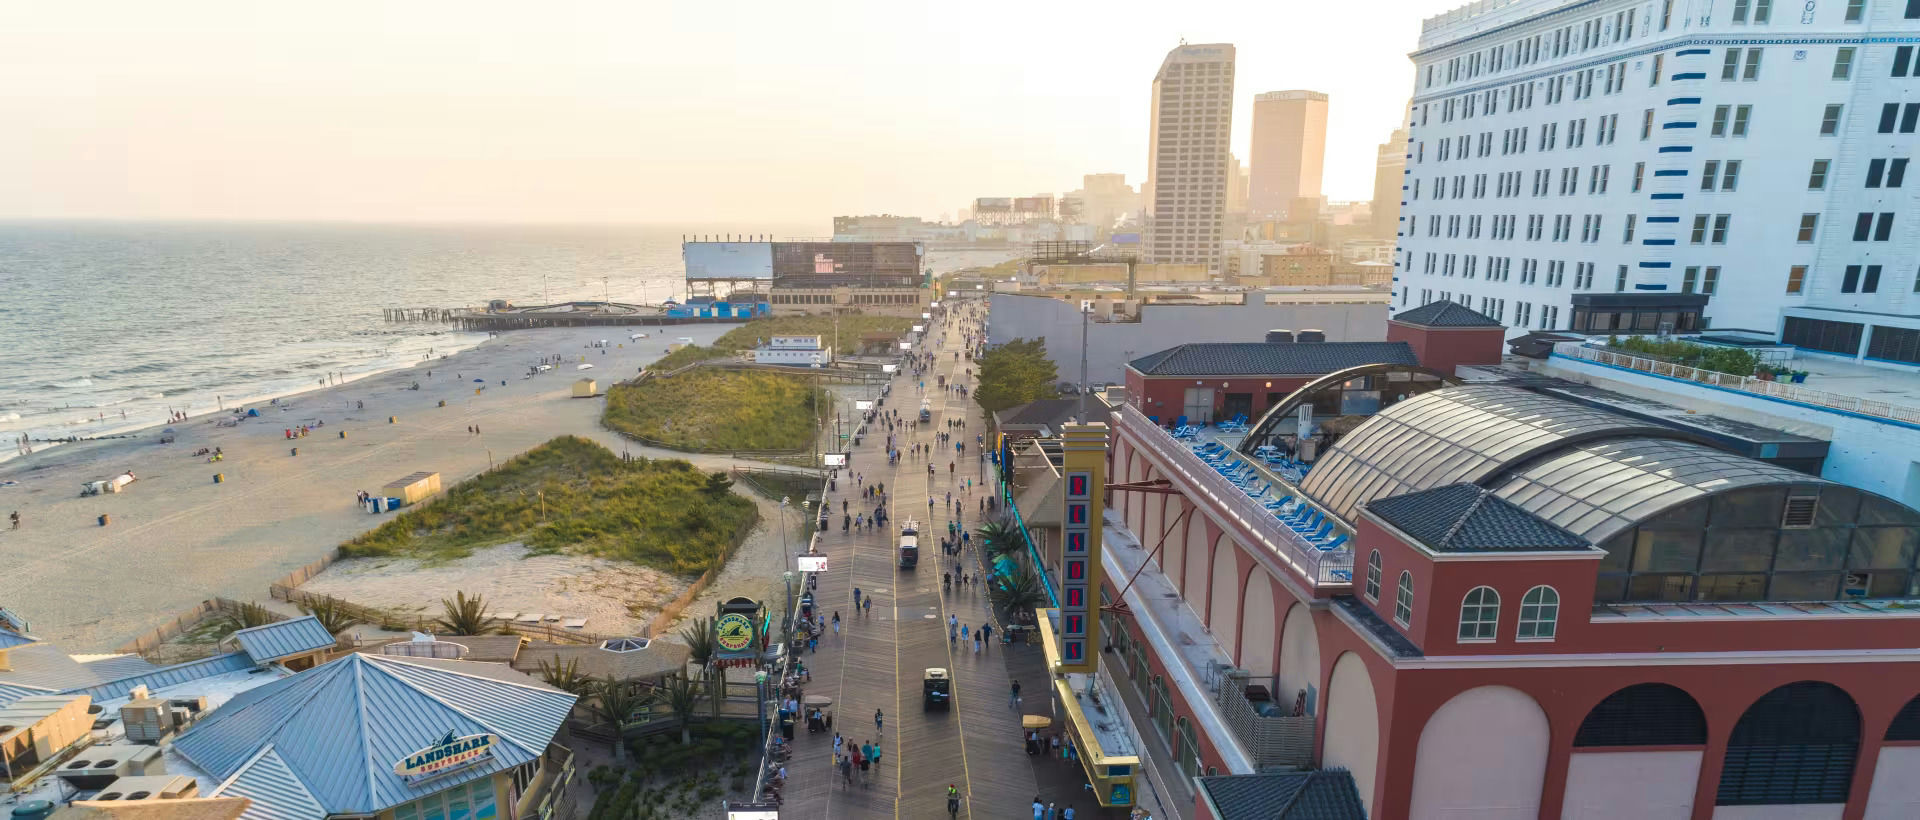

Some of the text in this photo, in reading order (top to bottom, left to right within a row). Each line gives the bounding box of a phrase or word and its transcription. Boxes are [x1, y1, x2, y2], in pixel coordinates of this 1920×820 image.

[1071, 477, 1084, 659] RESORTS
[717, 616, 750, 630] LANDSHARK
[404, 735, 490, 770] LANDSHARK
[420, 749, 480, 773] SURFSHACK
